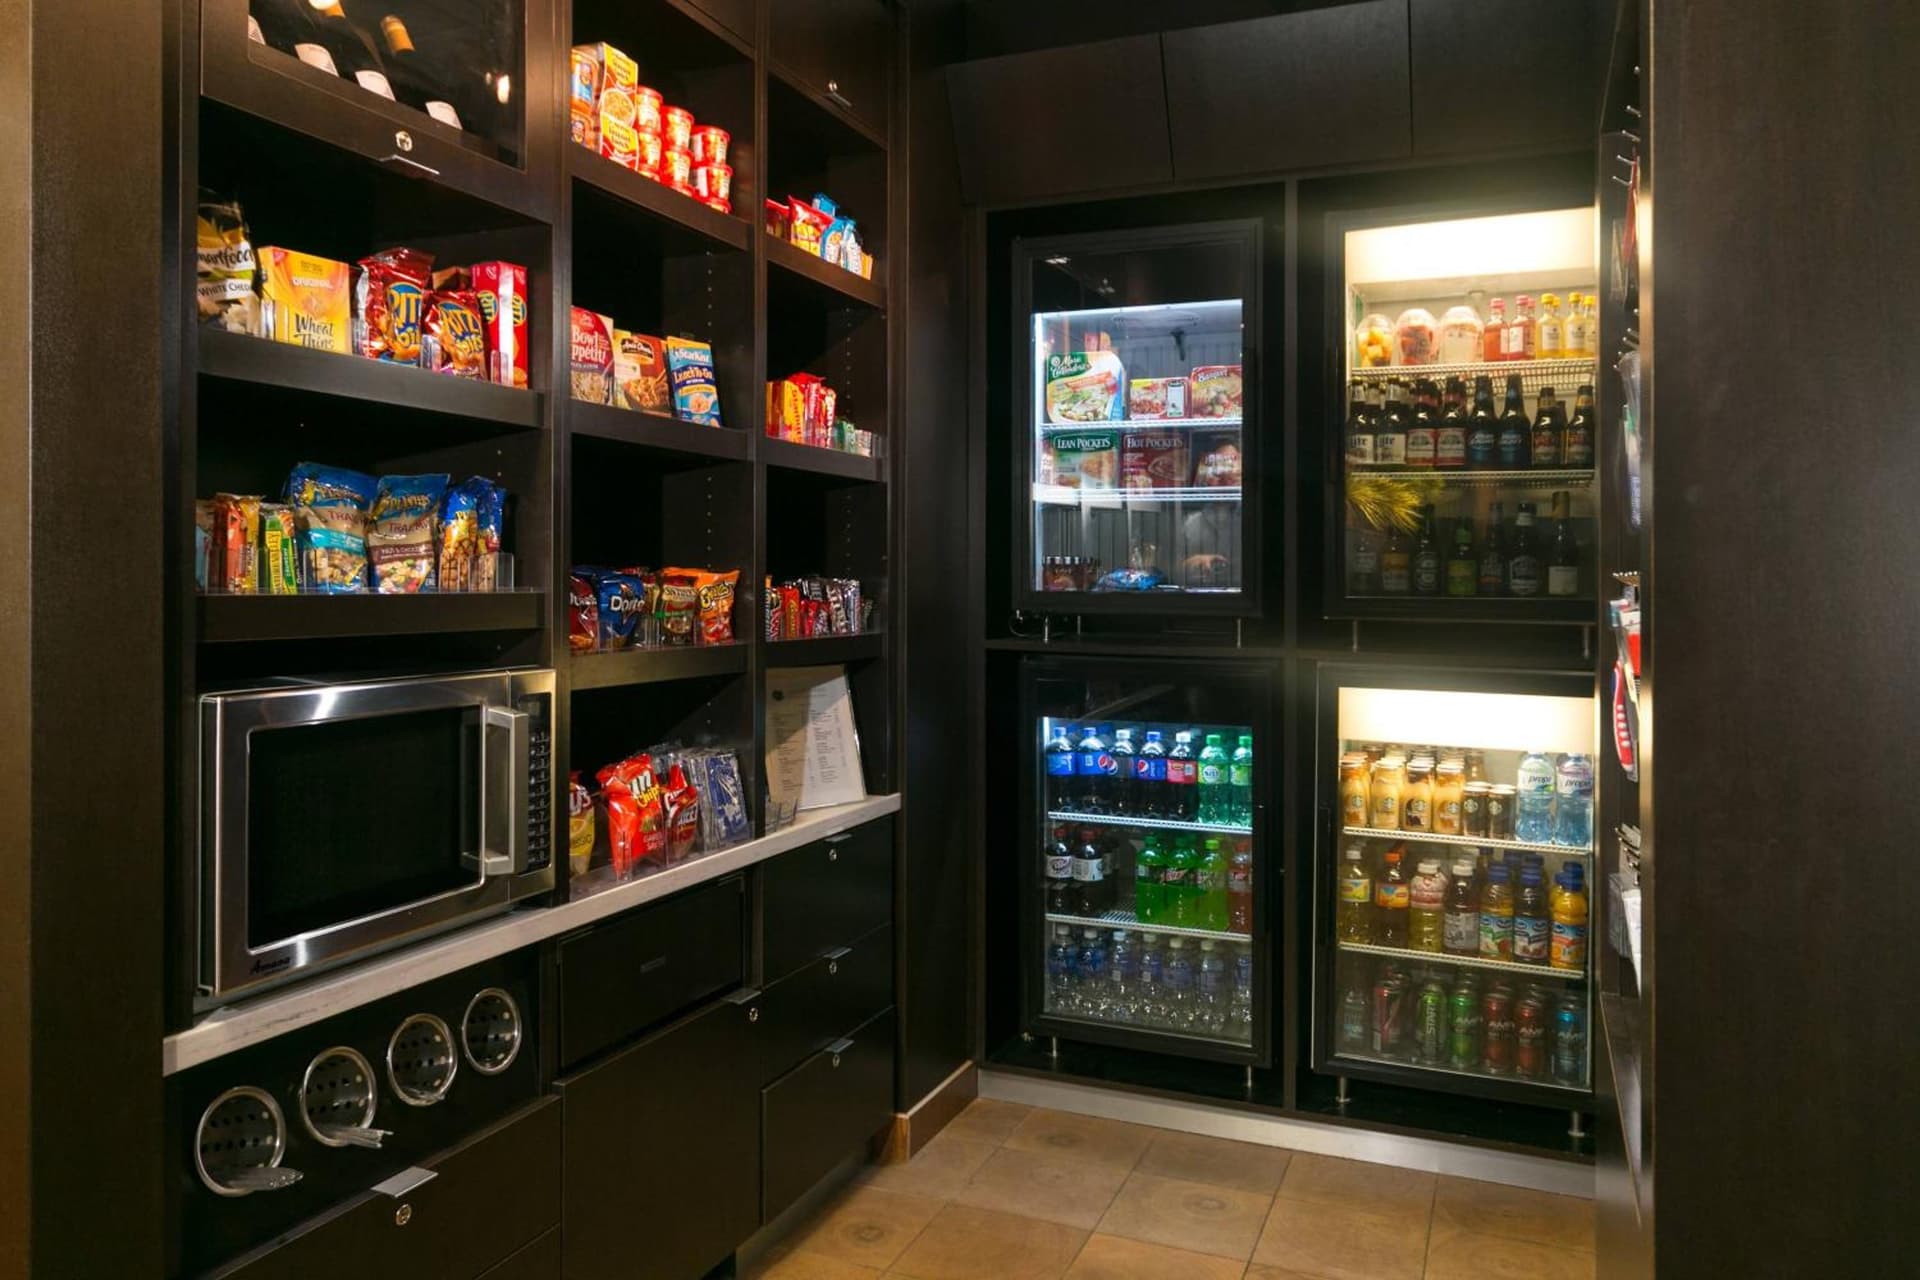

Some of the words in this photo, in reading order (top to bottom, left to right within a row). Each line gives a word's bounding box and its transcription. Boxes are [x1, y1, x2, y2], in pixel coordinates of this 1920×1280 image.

[295, 313, 334, 334] Wheat
[571, 325, 598, 346] Bowl
[571, 343, 606, 364] ppétit!
[1057, 438, 1076, 449] LEAN
[1077, 437, 1111, 449] POCKETS
[1127, 438, 1144, 449] HOT
[1145, 437, 1184, 448] POCKETS
[610, 594, 646, 613] Dorito
